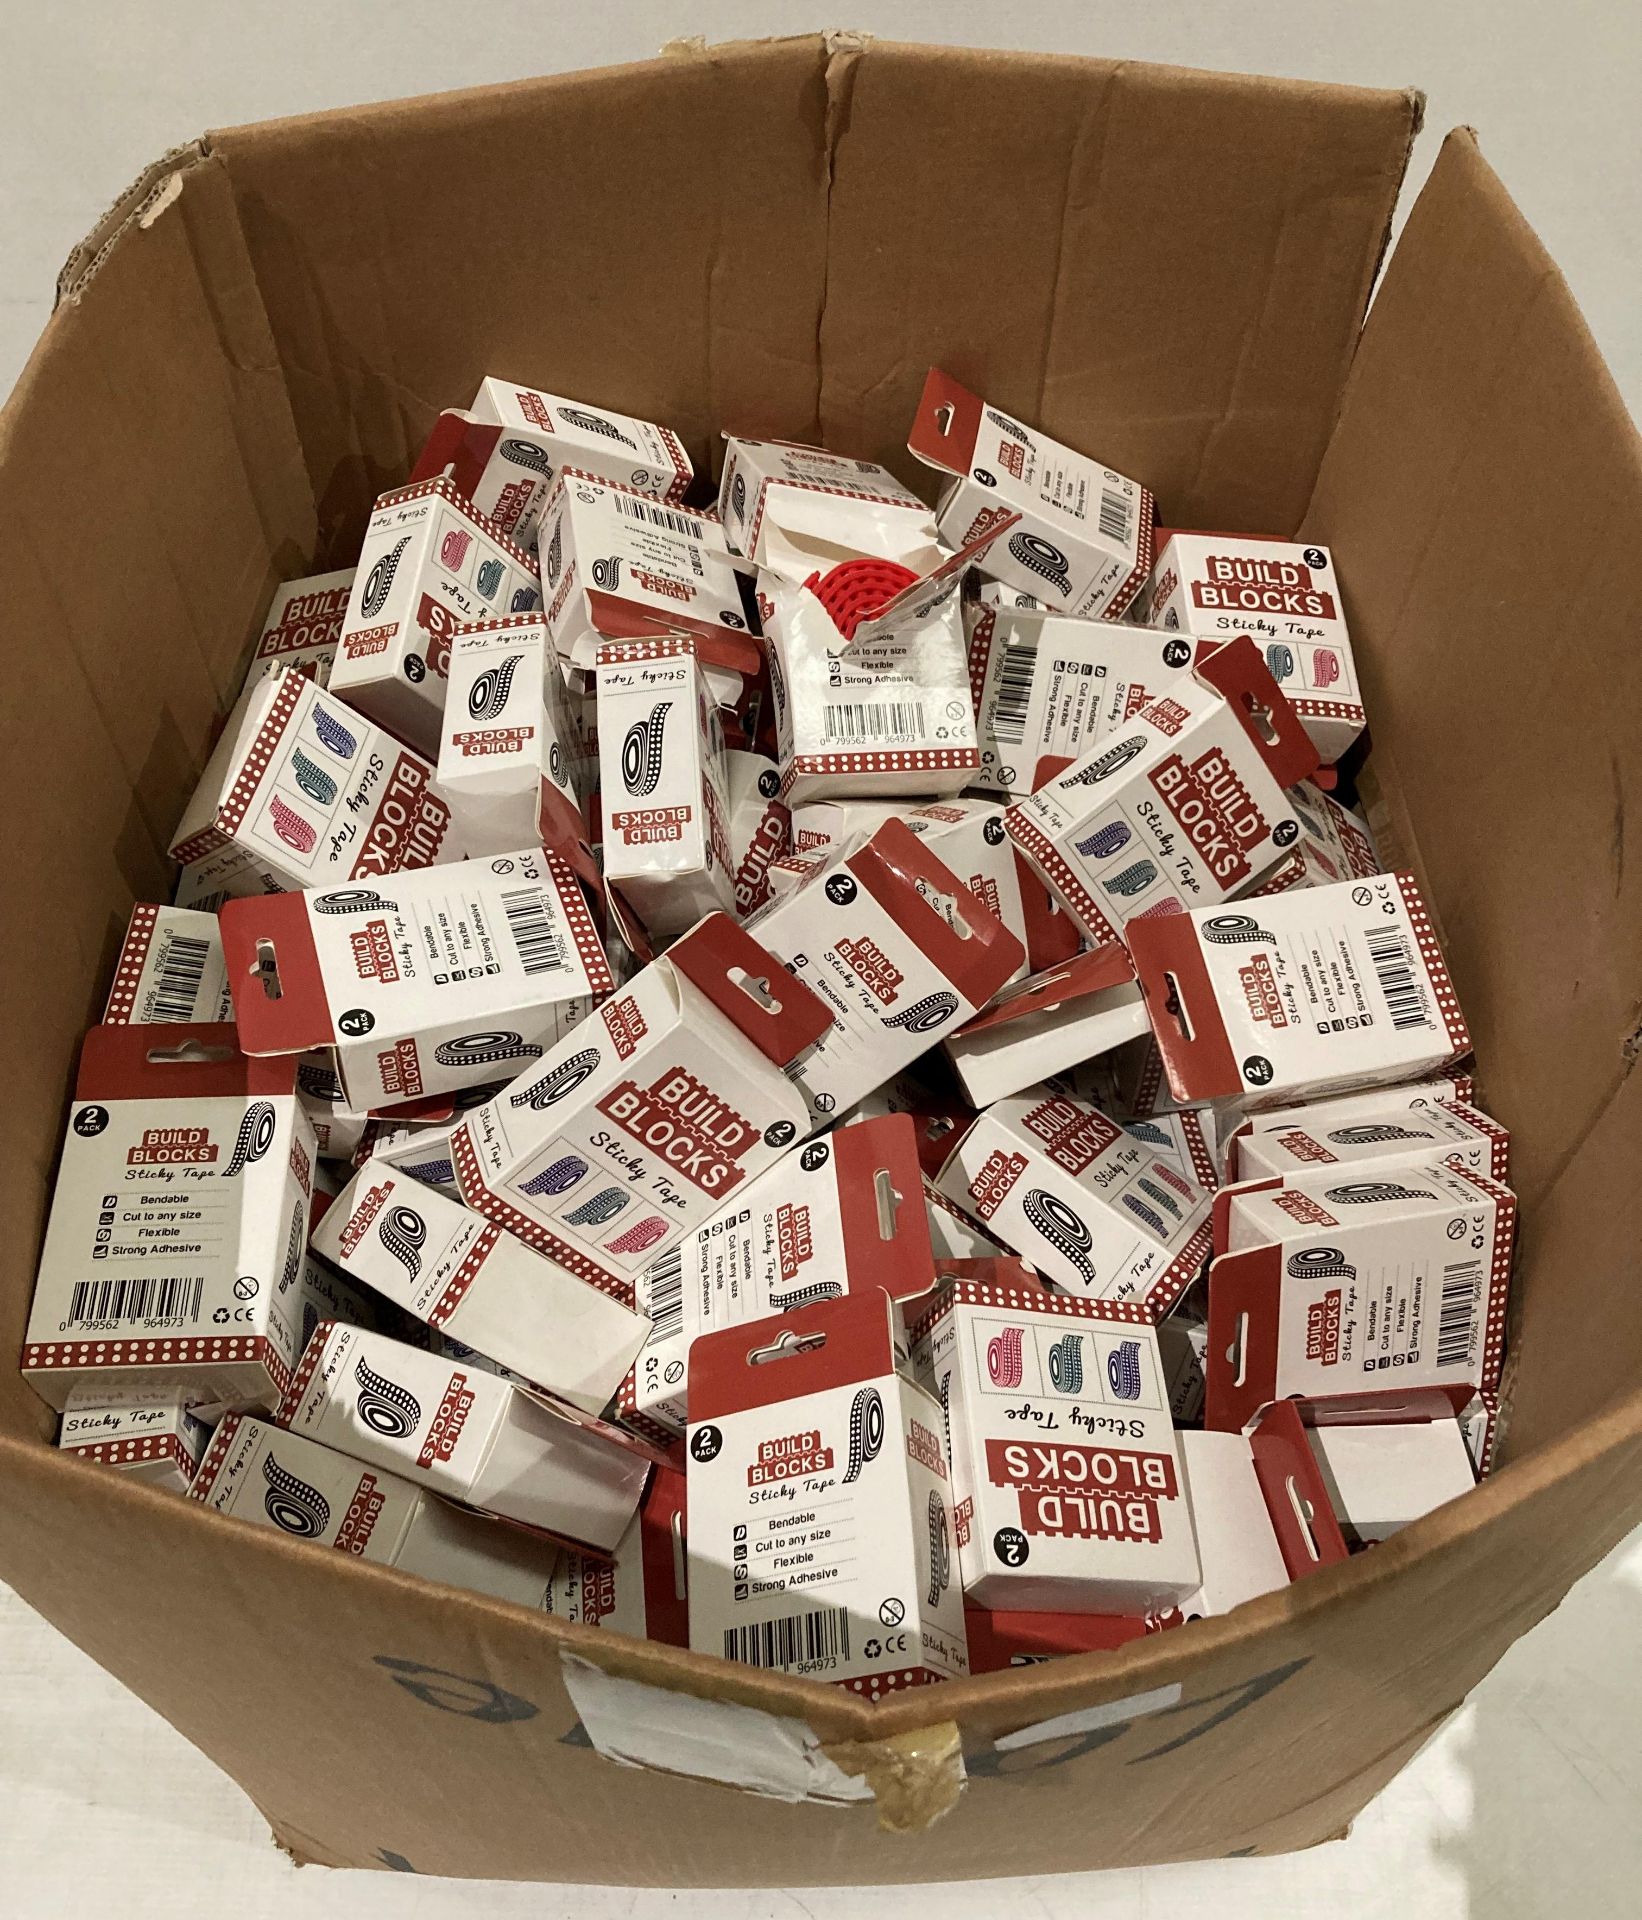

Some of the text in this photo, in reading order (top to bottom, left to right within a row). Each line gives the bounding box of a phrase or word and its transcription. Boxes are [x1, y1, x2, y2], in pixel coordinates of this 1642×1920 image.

[519, 393, 536, 423] BUILD
[529, 393, 552, 432] BLOCKS
[1000, 444, 1011, 465] BUILD
[1011, 448, 1024, 478] BLOCKS
[372, 507, 428, 527] Sticky Tape
[493, 487, 514, 523] BUILD
[504, 483, 534, 534] BLOCKS
[515, 482, 548, 539] Sticky Tape
[965, 513, 990, 545] BUILD
[1309, 550, 1319, 560] 2
[1215, 561, 1299, 585] BUILD
[441, 582, 472, 614] Tape
[1079, 563, 1120, 616] Sticky Tape
[1200, 586, 1324, 615] BLOCKS
[287, 592, 351, 622] BUILD
[264, 621, 343, 653] BLOCK
[349, 625, 396, 643] BLOCKS
[1217, 617, 1325, 639] Sticky Tape
[352, 640, 385, 656] BUILD
[1174, 649, 1189, 661] 2
[604, 670, 687, 686] Sticky Tape
[844, 676, 872, 685] Strong
[861, 661, 894, 670] Flexible
[1043, 674, 1062, 743] Strong Adhesive
[1107, 682, 1126, 722] Sticky
[1158, 700, 1186, 721] BUILD
[460, 728, 530, 743] BLOCKS
[1141, 708, 1178, 735] BLOCKS
[470, 741, 517, 753] BUILD
[329, 754, 384, 863] Sticky Tape
[1029, 795, 1064, 829] Sticky Tape
[1199, 757, 1258, 838] BUILD
[619, 809, 687, 826] BLOCKS
[1156, 764, 1239, 877] BLOCKS
[1282, 823, 1296, 836] 2
[631, 827, 678, 842] BUILD
[801, 833, 827, 845] BUILD
[1137, 801, 1201, 894] Sticky Tape
[736, 817, 783, 906] BUILD
[827, 883, 845, 904] PACK
[839, 878, 854, 892] 2
[355, 937, 374, 975] BUILD
[372, 925, 396, 981] BLOCKS
[424, 925, 438, 958] Bendable
[838, 943, 891, 999] BLOCKS
[860, 941, 897, 982] BUILD
[1338, 940, 1366, 1012] Strong Adhesive
[823, 952, 879, 1015] Sticky Tape
[1242, 973, 1266, 1017] BUILD
[1256, 961, 1284, 1024] BLOCKS
[1300, 964, 1317, 1004] Bendable
[1331, 962, 1346, 996] Flexible
[817, 979, 848, 1014] Bendable
[341, 1019, 359, 1030] 2
[603, 1005, 632, 1055] BLOCKS
[621, 1000, 645, 1035] BUILD
[383, 1055, 400, 1093] BUILD
[402, 1043, 421, 1095] BLOCKS
[1245, 1065, 1264, 1078] 2
[85, 1109, 97, 1123] 2
[660, 1076, 745, 1149] BUILD
[1030, 1102, 1076, 1139] BUILD
[147, 1131, 201, 1145] BUILD
[479, 1108, 502, 1170] Sticky Tape
[607, 1092, 729, 1193] BLOCKS
[765, 1131, 783, 1147] PACK
[778, 1124, 791, 1138] 2
[1054, 1118, 1114, 1171] BLOCKS
[132, 1148, 210, 1163] BLOCKS
[590, 1131, 687, 1209] Sticky Tape
[812, 1147, 827, 1161] 2
[1094, 1149, 1139, 1188] Sticky Tape
[125, 1167, 215, 1182] Sticky Tape
[972, 1158, 1002, 1198] BUILD
[980, 1160, 1023, 1217] BLOCKS
[141, 1194, 189, 1205] Bendable
[1277, 1200, 1309, 1223] BUILD
[1290, 1193, 1335, 1226] BLOCKS
[123, 1210, 201, 1222] Cut to any size
[138, 1227, 180, 1237] Flexible
[343, 1193, 374, 1240] BUILD
[345, 1188, 389, 1254] BLOCKS
[112, 1243, 201, 1256] Strong Adhesive
[779, 1209, 795, 1274] BLOCKS
[796, 1211, 810, 1256] BUILD
[417, 1223, 475, 1310] Sticky Tape
[762, 1214, 776, 1289] Sticky Tape
[701, 1244, 710, 1316] Strong Adhesive
[59, 1317, 184, 1332] 0 799562 964973
[1310, 1309, 1321, 1358] BUILD
[1324, 1297, 1339, 1362] BLOCKS
[304, 1331, 351, 1424] Sticky Tape
[65, 1410, 166, 1432] Sticky Tape
[422, 1378, 463, 1460] BLOCKS
[442, 1395, 471, 1453] BUILD
[1004, 1403, 1145, 1438] Sticky Tape
[229, 1425, 259, 1478] Sticky
[695, 1446, 717, 1457] PACK
[699, 1428, 712, 1447] 2
[763, 1435, 813, 1460] BUILD
[911, 1425, 937, 1450] BUILD
[752, 1454, 826, 1483] BLOCKS
[909, 1440, 945, 1476] BLOCKS
[1008, 1446, 1166, 1489] BLOCKS
[749, 1478, 836, 1504] Sticky Tape
[351, 1498, 382, 1555] BUILD
[769, 1511, 815, 1530] Bendable
[1038, 1496, 1150, 1534] BUILD
[755, 1529, 831, 1553] Cut to any size
[1000, 1535, 1023, 1543] PACK
[1006, 1544, 1020, 1564] 2
[773, 1552, 813, 1569] Flexible
[752, 1567, 838, 1594] Strong Adhesive
[797, 1657, 837, 1674] 964973
